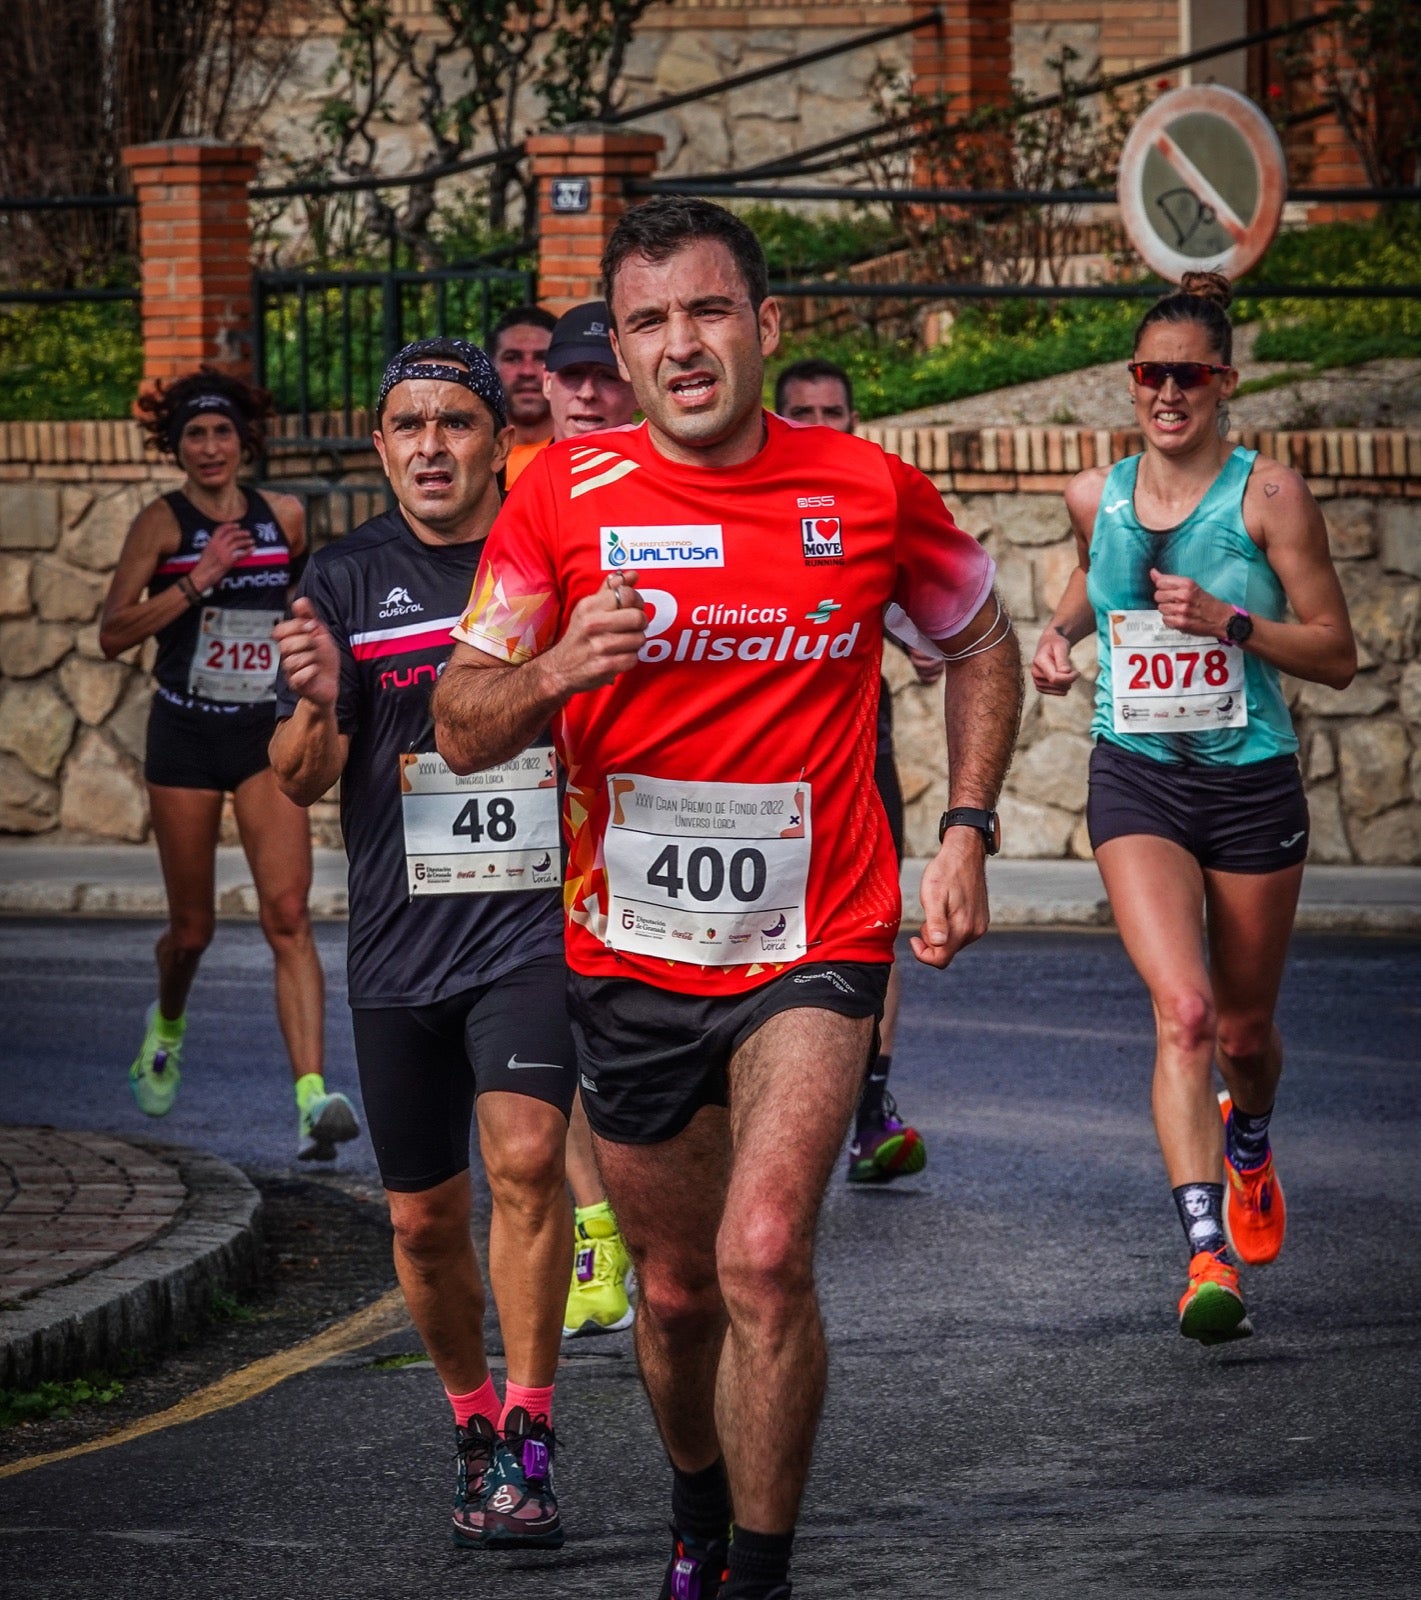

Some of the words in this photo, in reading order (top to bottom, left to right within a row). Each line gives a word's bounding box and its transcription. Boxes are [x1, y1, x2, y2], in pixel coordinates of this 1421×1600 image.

[804, 543, 842, 555] MOVE
[691, 604, 788, 625] Clínicas
[207, 641, 272, 670] 2129
[1128, 650, 1229, 690] 2078
[522, 757, 541, 770] 2022
[635, 792, 654, 808] XXXV
[655, 796, 677, 812] GRAN
[681, 798, 712, 814] PREMIO
[715, 802, 726, 814] DE
[729, 800, 758, 815] FONDO
[760, 800, 784, 815] 2022
[452, 797, 516, 843] 48
[675, 815, 710, 828] UNIVERSO
[713, 817, 736, 829] LORCA
[646, 844, 767, 902] 400
[761, 936, 785, 951] Lorca
